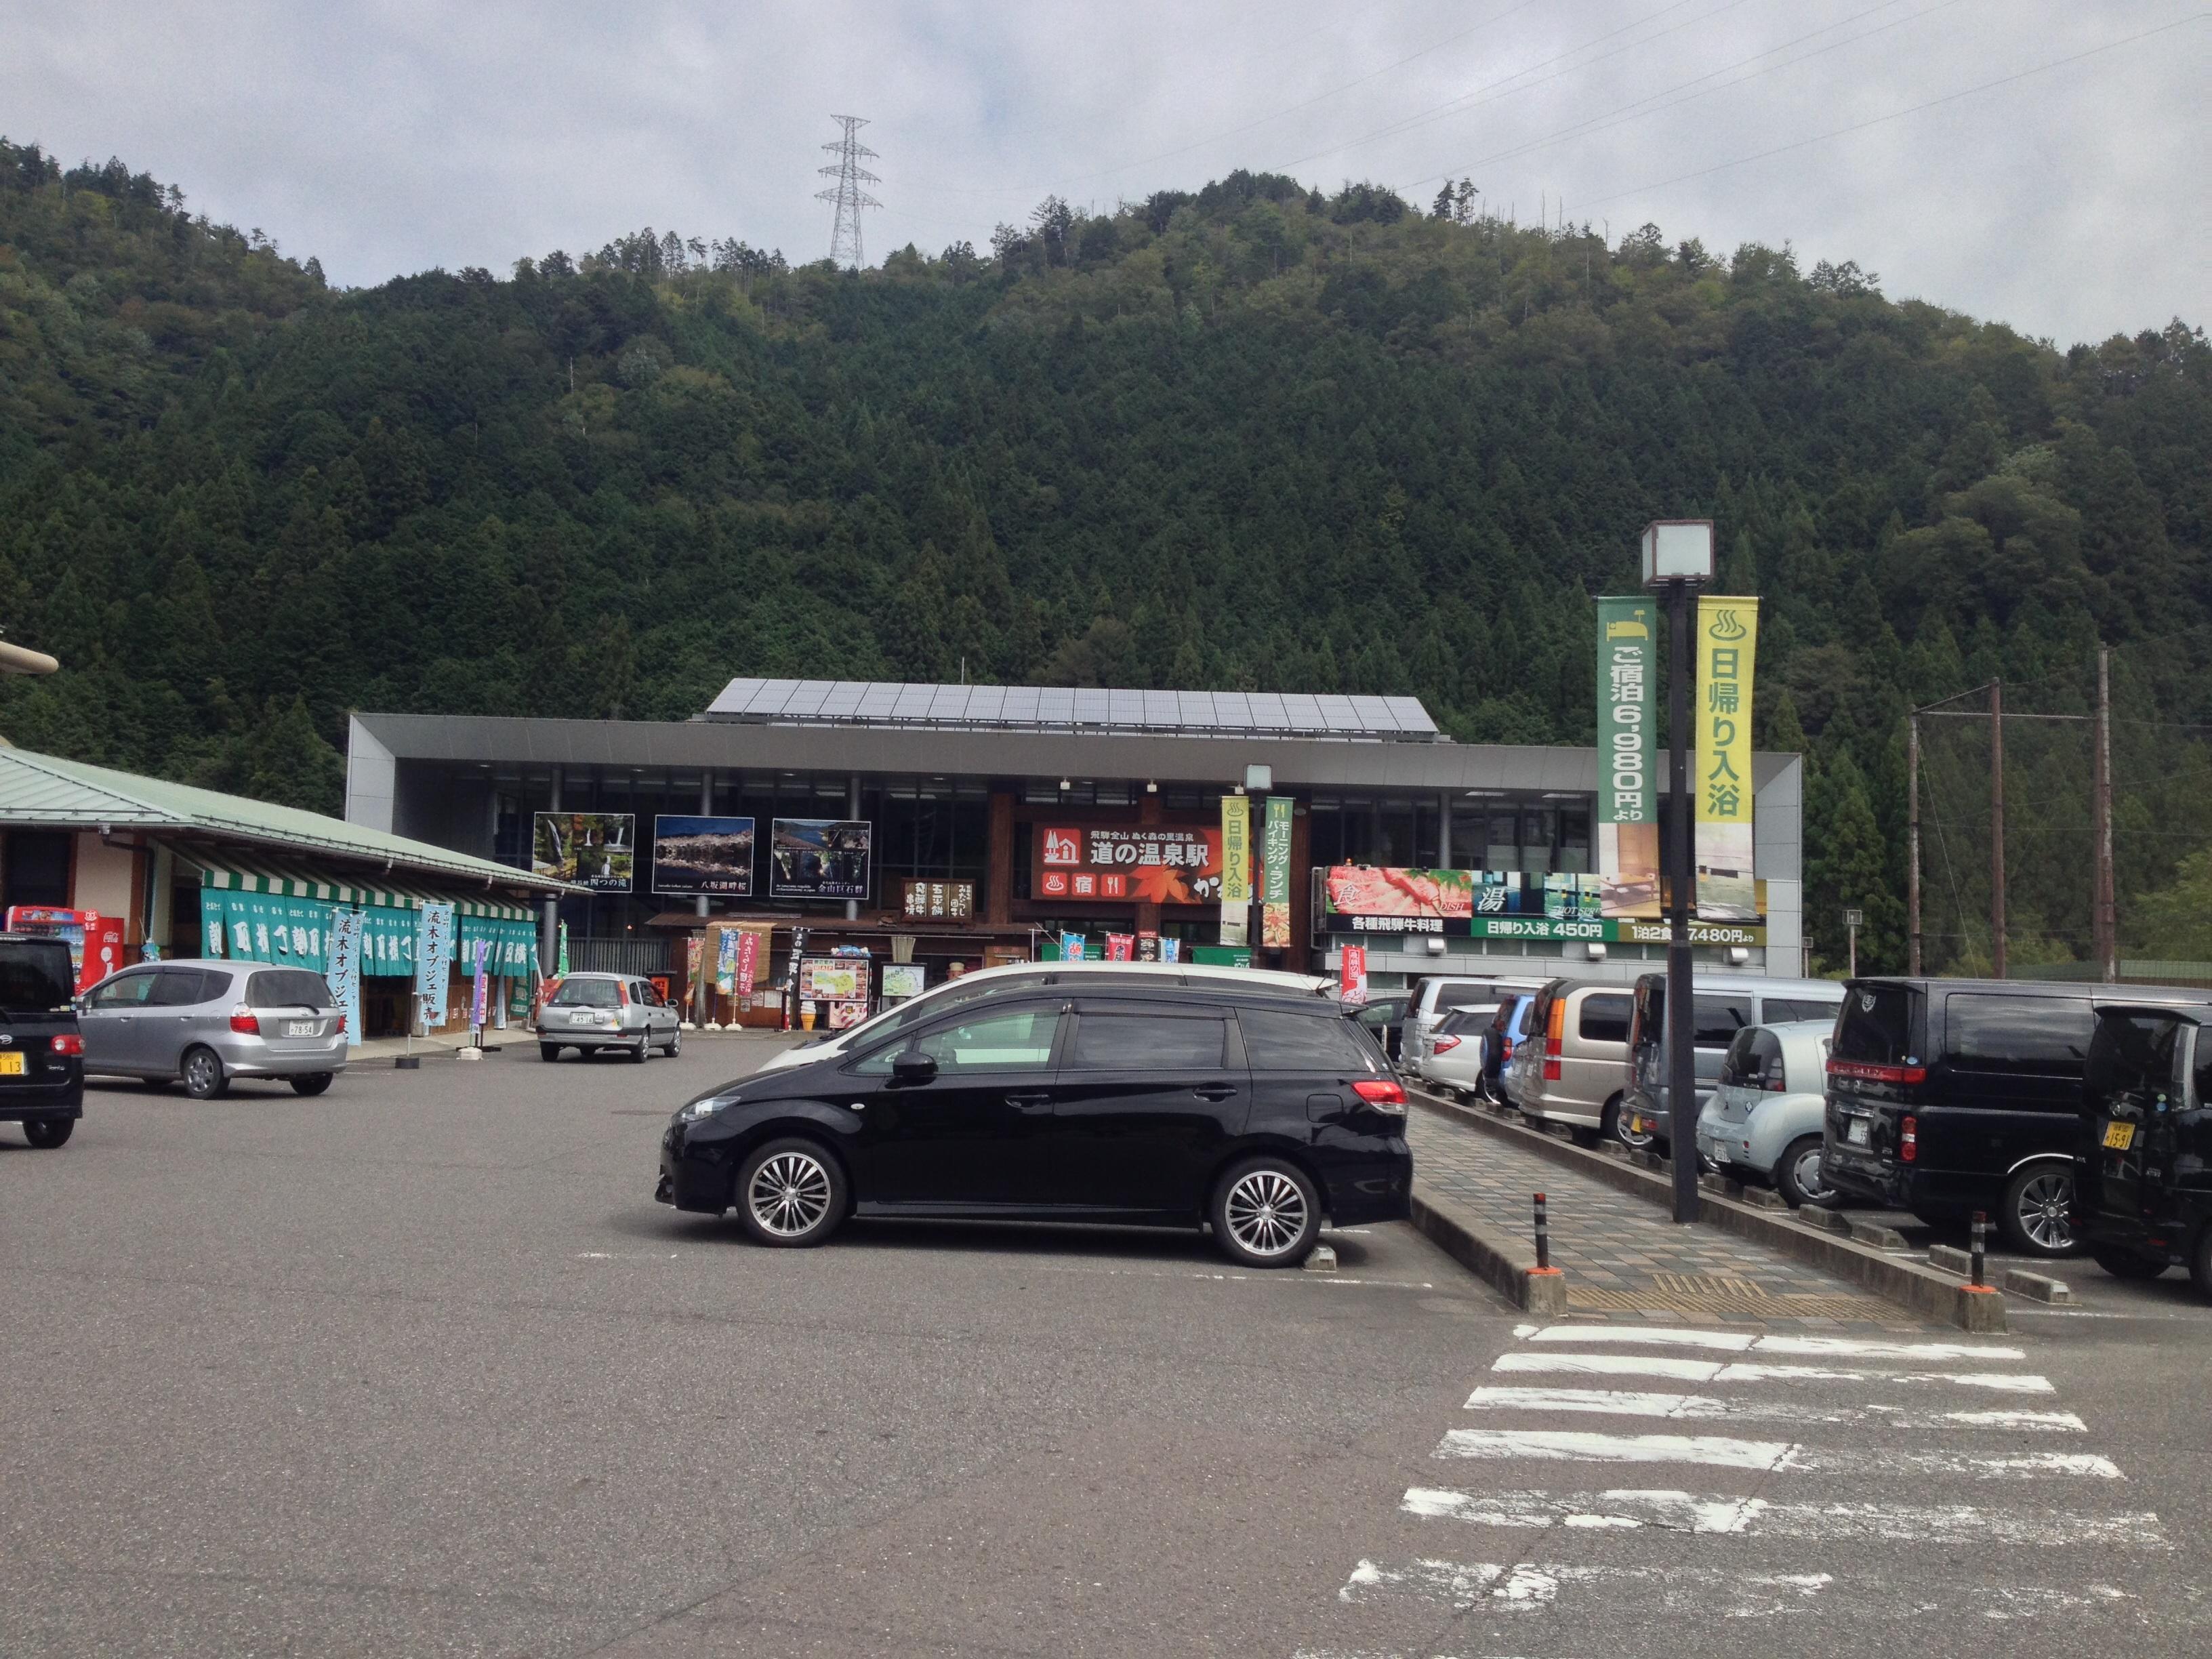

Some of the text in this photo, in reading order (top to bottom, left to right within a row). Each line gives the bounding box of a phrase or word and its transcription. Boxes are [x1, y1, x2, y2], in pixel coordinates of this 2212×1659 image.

[1610, 646, 1643, 821] ご宿泊6,980円より
[1707, 647, 1740, 817] 日帰り入浴
[1090, 830, 1195, 842] 飛騨金山 ぬく森の里温泉
[1267, 820, 1279, 865] バイキング
[1278, 821, 1290, 865] モーニング
[1090, 842, 1210, 867] 道の温泉駅
[1227, 819, 1242, 899] 日帰り入浴
[818, 884, 864, 894] 金山巨石群
[1075, 875, 1092, 894] 宿
[1333, 882, 1361, 907] 食
[931, 884, 944, 916] 五平餅
[950, 899, 959, 917] 団子
[1439, 901, 1465, 912] DISH
[1477, 886, 1507, 912] 湯
[1351, 916, 1444, 933] 各種飛騨牛料理
[1487, 920, 1603, 938] 日帰り入浴 450円
[422, 910, 441, 1021] 流木オブジェ販売
